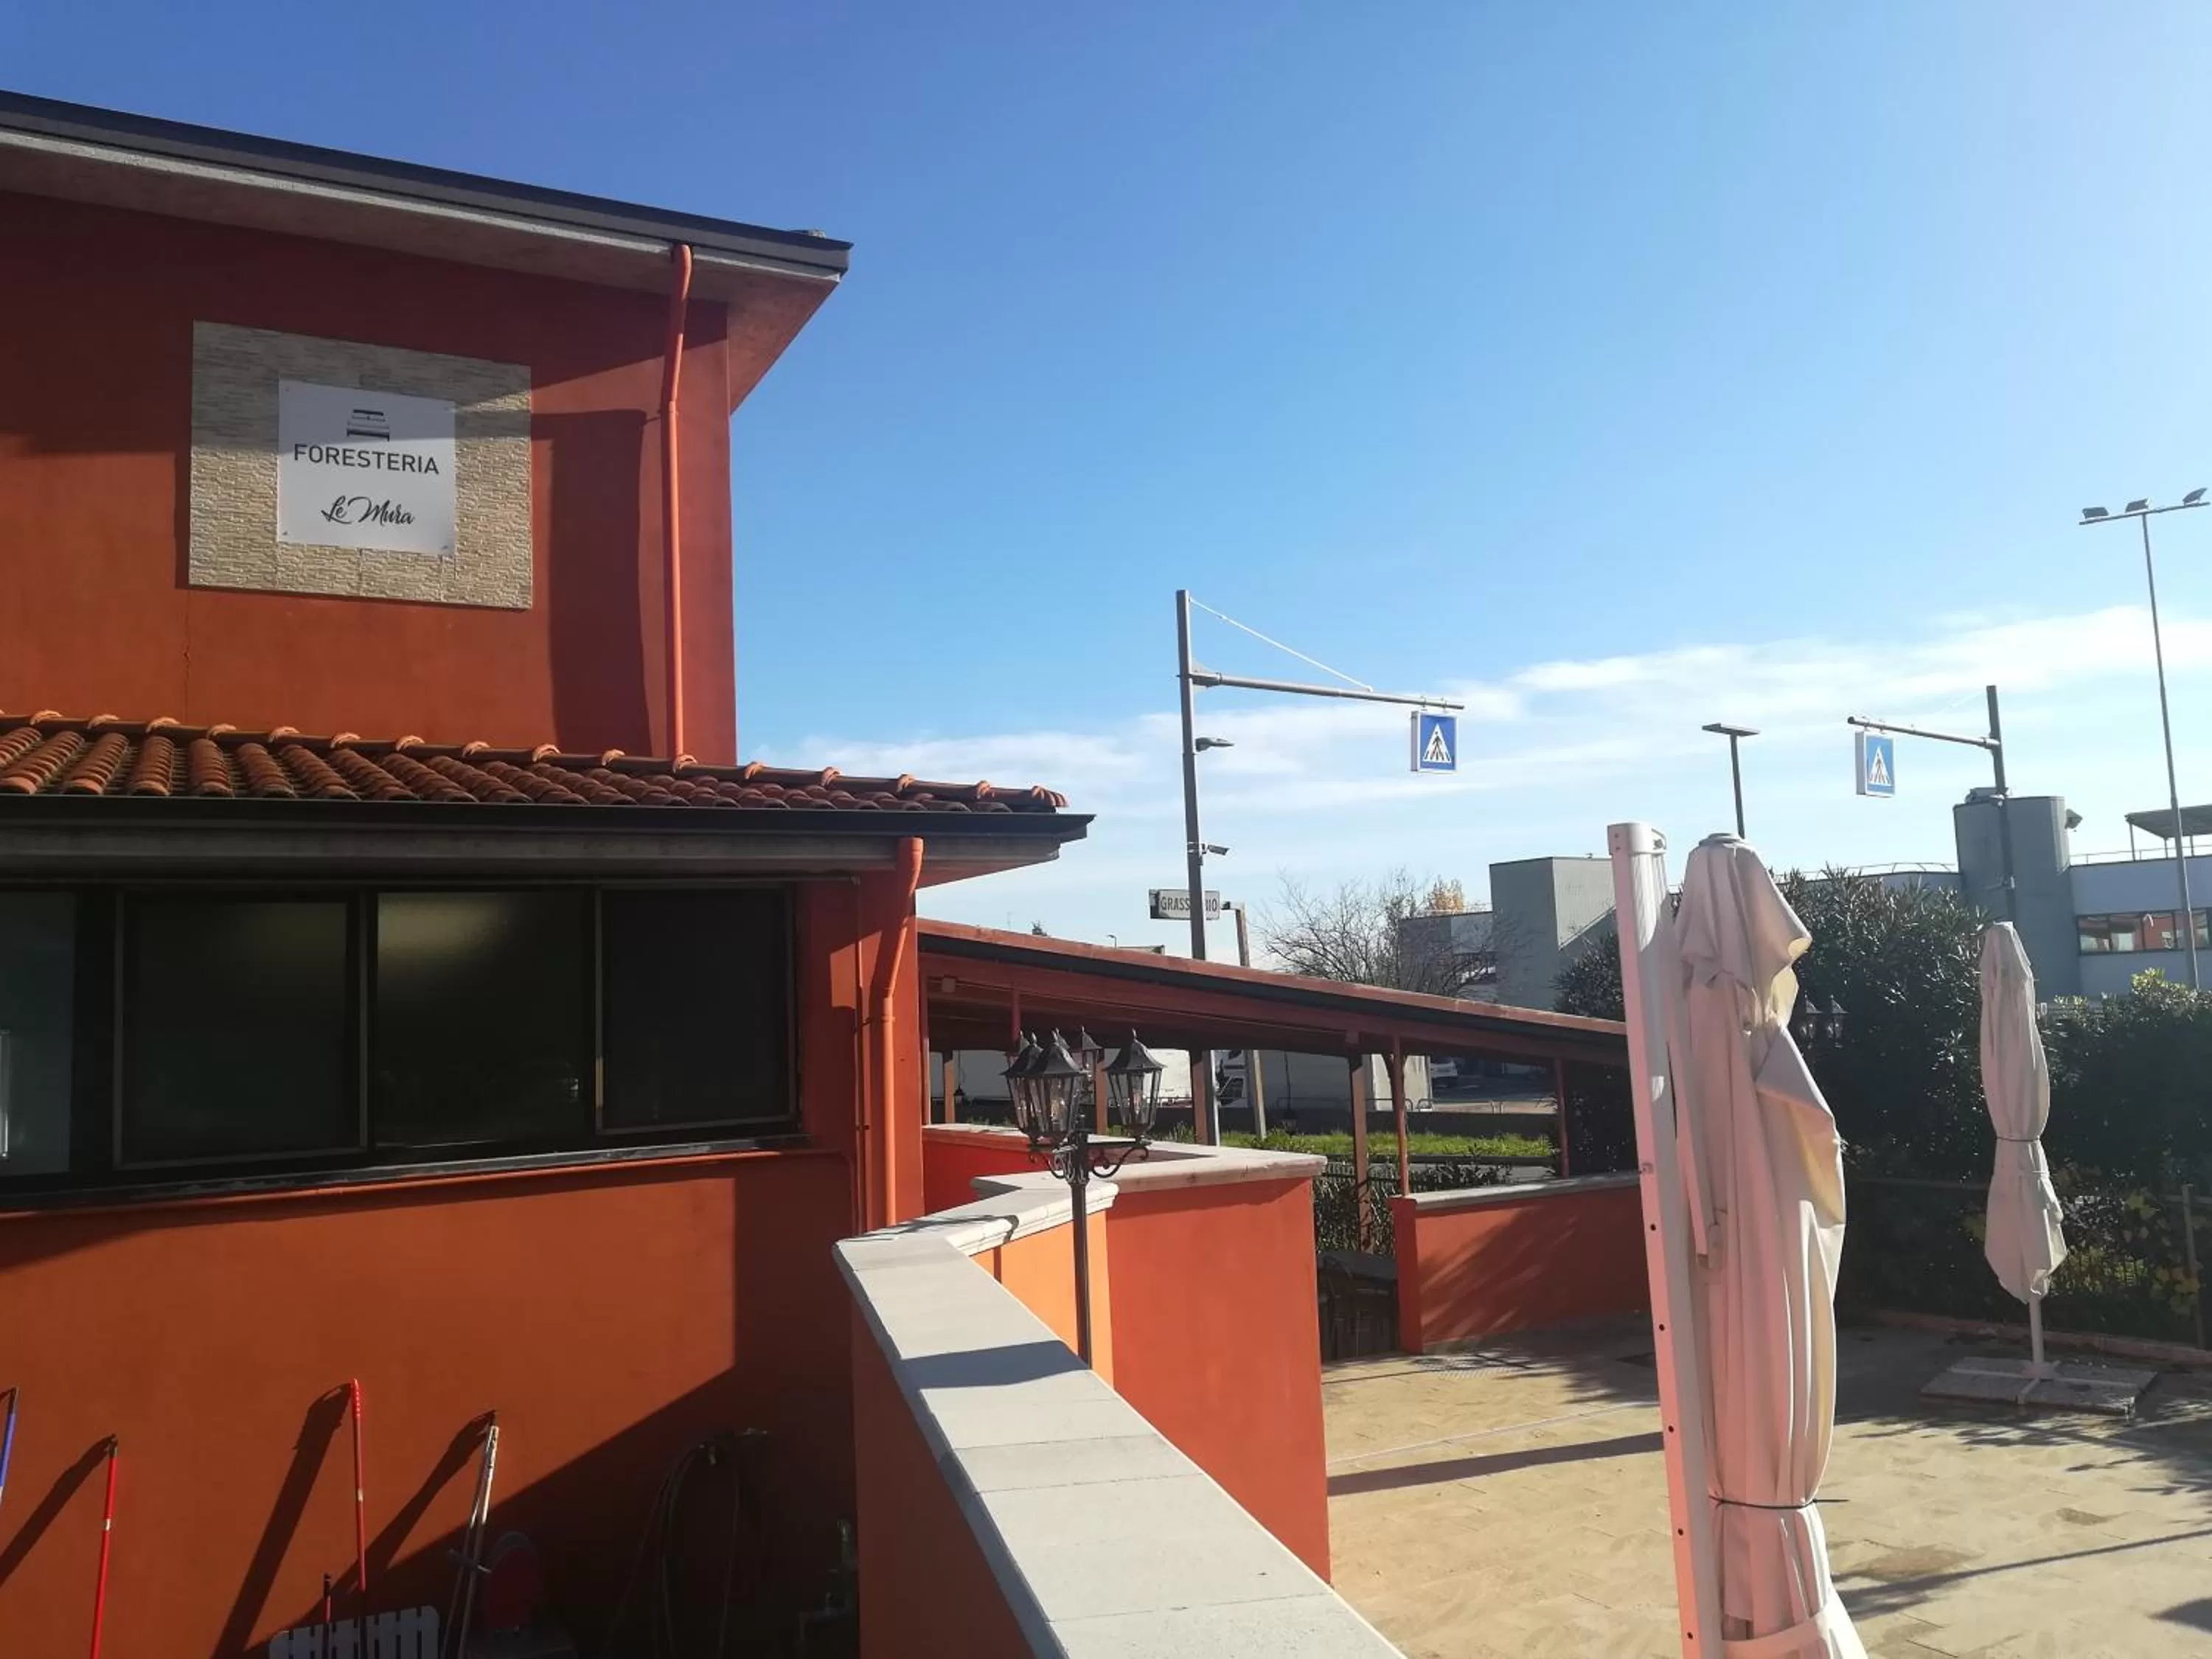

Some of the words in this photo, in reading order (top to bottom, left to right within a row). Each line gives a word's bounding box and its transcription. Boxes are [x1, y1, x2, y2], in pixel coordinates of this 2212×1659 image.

[294, 443, 439, 475] FORESTERIA
[321, 495, 352, 524] Le
[347, 496, 416, 526] Mura
[1160, 896, 1218, 912] GRASSIO
